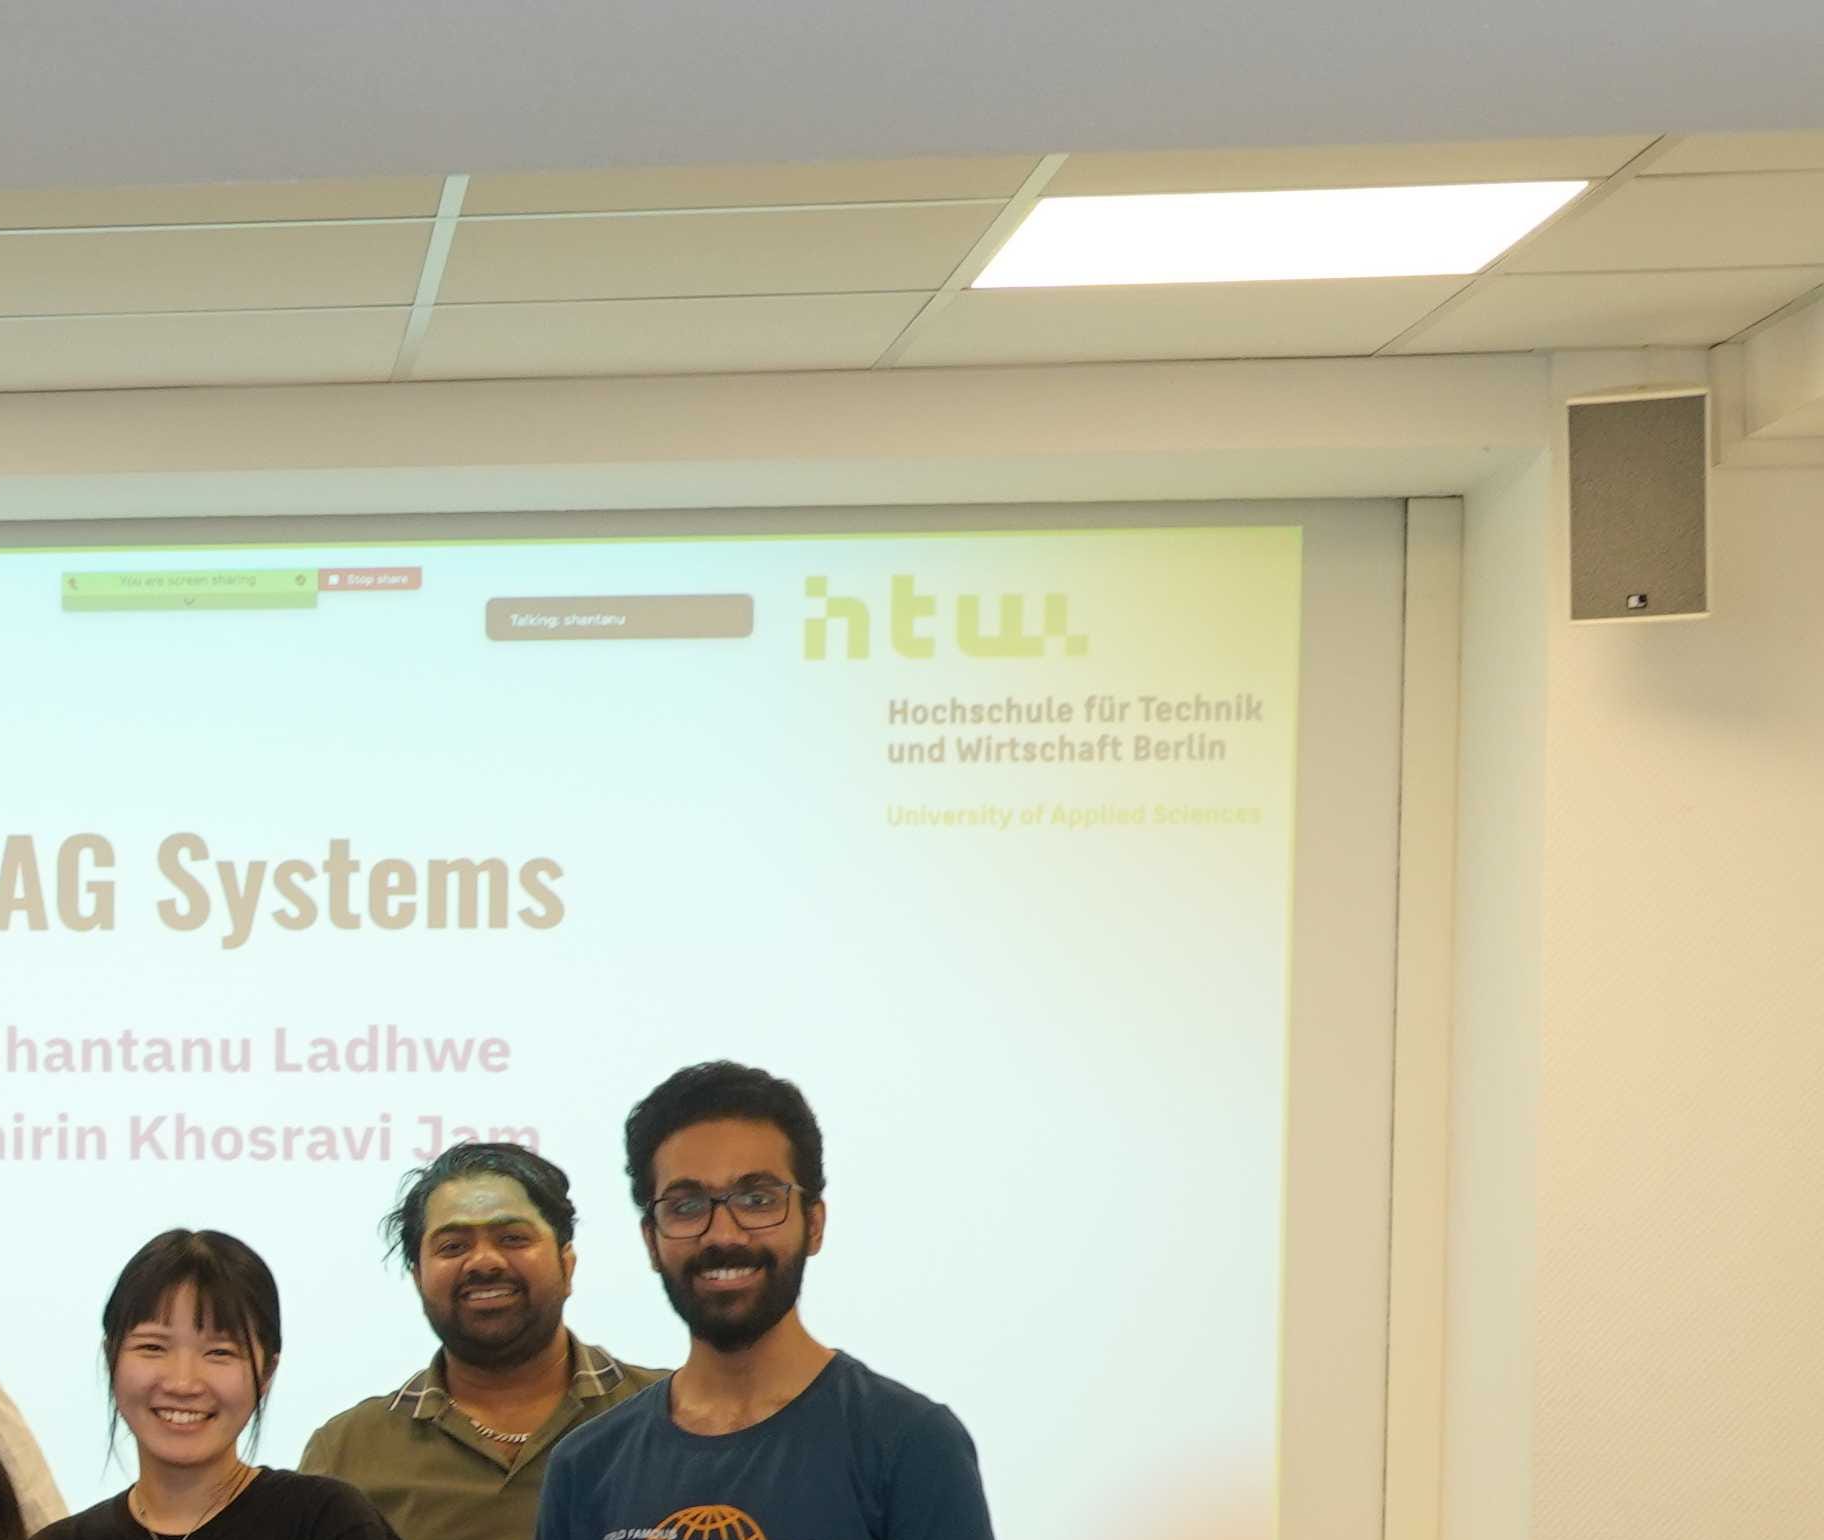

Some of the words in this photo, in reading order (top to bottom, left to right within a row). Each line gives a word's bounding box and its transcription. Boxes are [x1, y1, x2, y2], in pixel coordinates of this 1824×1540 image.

[167, 576, 209, 587] screen
[212, 574, 257, 588] sharing
[376, 574, 408, 585] share
[888, 697, 1074, 725] Hochschule
[1084, 695, 1131, 723] für
[1138, 693, 1263, 722] Technik
[887, 736, 946, 764] und
[956, 735, 1123, 763] Wirtschaft
[1133, 734, 1227, 761] Berlin
[887, 805, 1014, 831] University
[1020, 805, 1045, 826] of
[1050, 804, 1146, 829] Applied
[1152, 804, 1262, 825] Sciences
[155, 832, 566, 950] Systems
[274, 1023, 512, 1073] Ladhwe
[129, 1111, 392, 1162] Khosravi
[626, 1527, 679, 1540] FAMOUS
